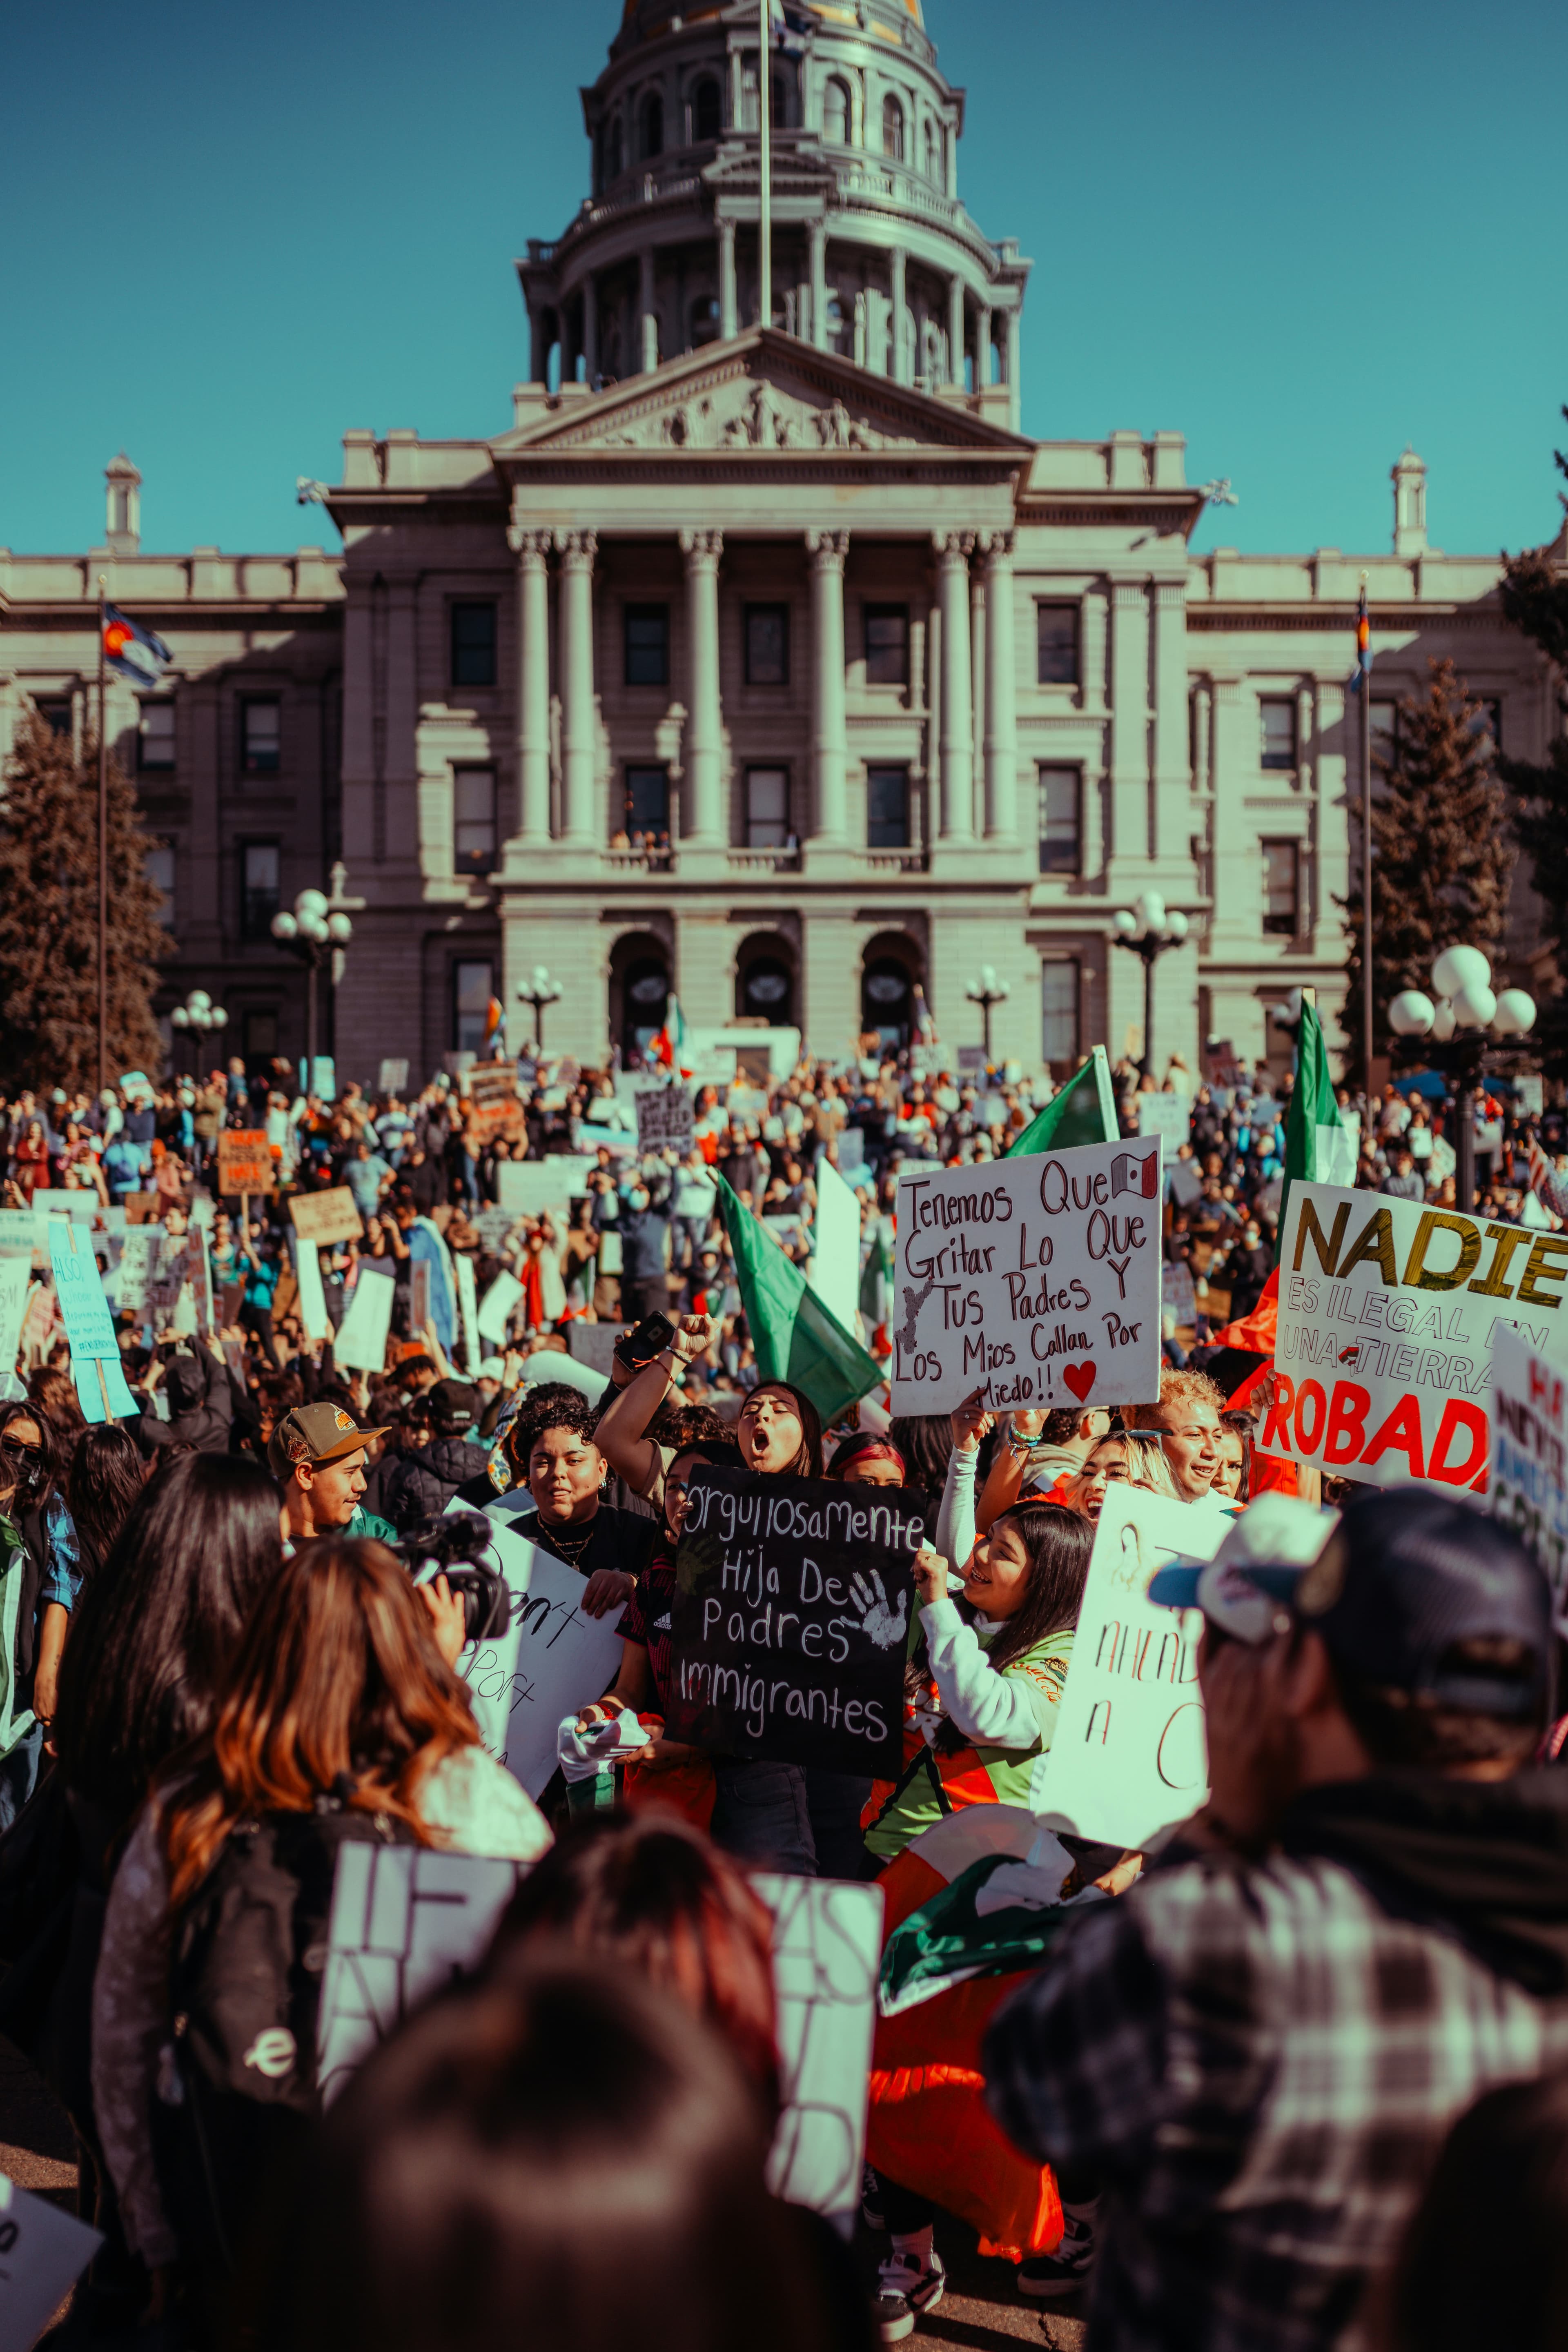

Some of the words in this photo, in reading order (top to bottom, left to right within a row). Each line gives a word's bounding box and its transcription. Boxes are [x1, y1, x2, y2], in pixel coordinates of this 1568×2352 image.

[901, 1180, 1013, 1230] Tenemos
[1040, 1160, 1109, 1215] Que
[53, 1256, 85, 1283] ALSO,
[905, 1229, 996, 1279] Gritar
[1020, 1223, 1054, 1271] Lo
[1087, 1209, 1147, 1260] Que
[1292, 1198, 1568, 1309] NADIE
[932, 1283, 984, 1330] Tus
[1001, 1271, 1091, 1321] Padres
[1107, 1256, 1131, 1301] Y
[1287, 1277, 1321, 1314] ES
[1327, 1285, 1470, 1343] ILEGAL
[895, 1338, 943, 1382] Los
[964, 1330, 1016, 1376] Mios
[1031, 1323, 1094, 1361] Callan
[1101, 1312, 1142, 1349] Por
[1283, 1324, 1338, 1368] UNA
[1261, 1372, 1490, 1494] ROBAD
[722, 1544, 780, 1608] Hija
[799, 1558, 849, 1606] De
[653, 1621, 672, 1630] adidas
[703, 1597, 853, 1663] Padres
[681, 1658, 888, 1742] Immigrantes
[1085, 1699, 1112, 1745] A
